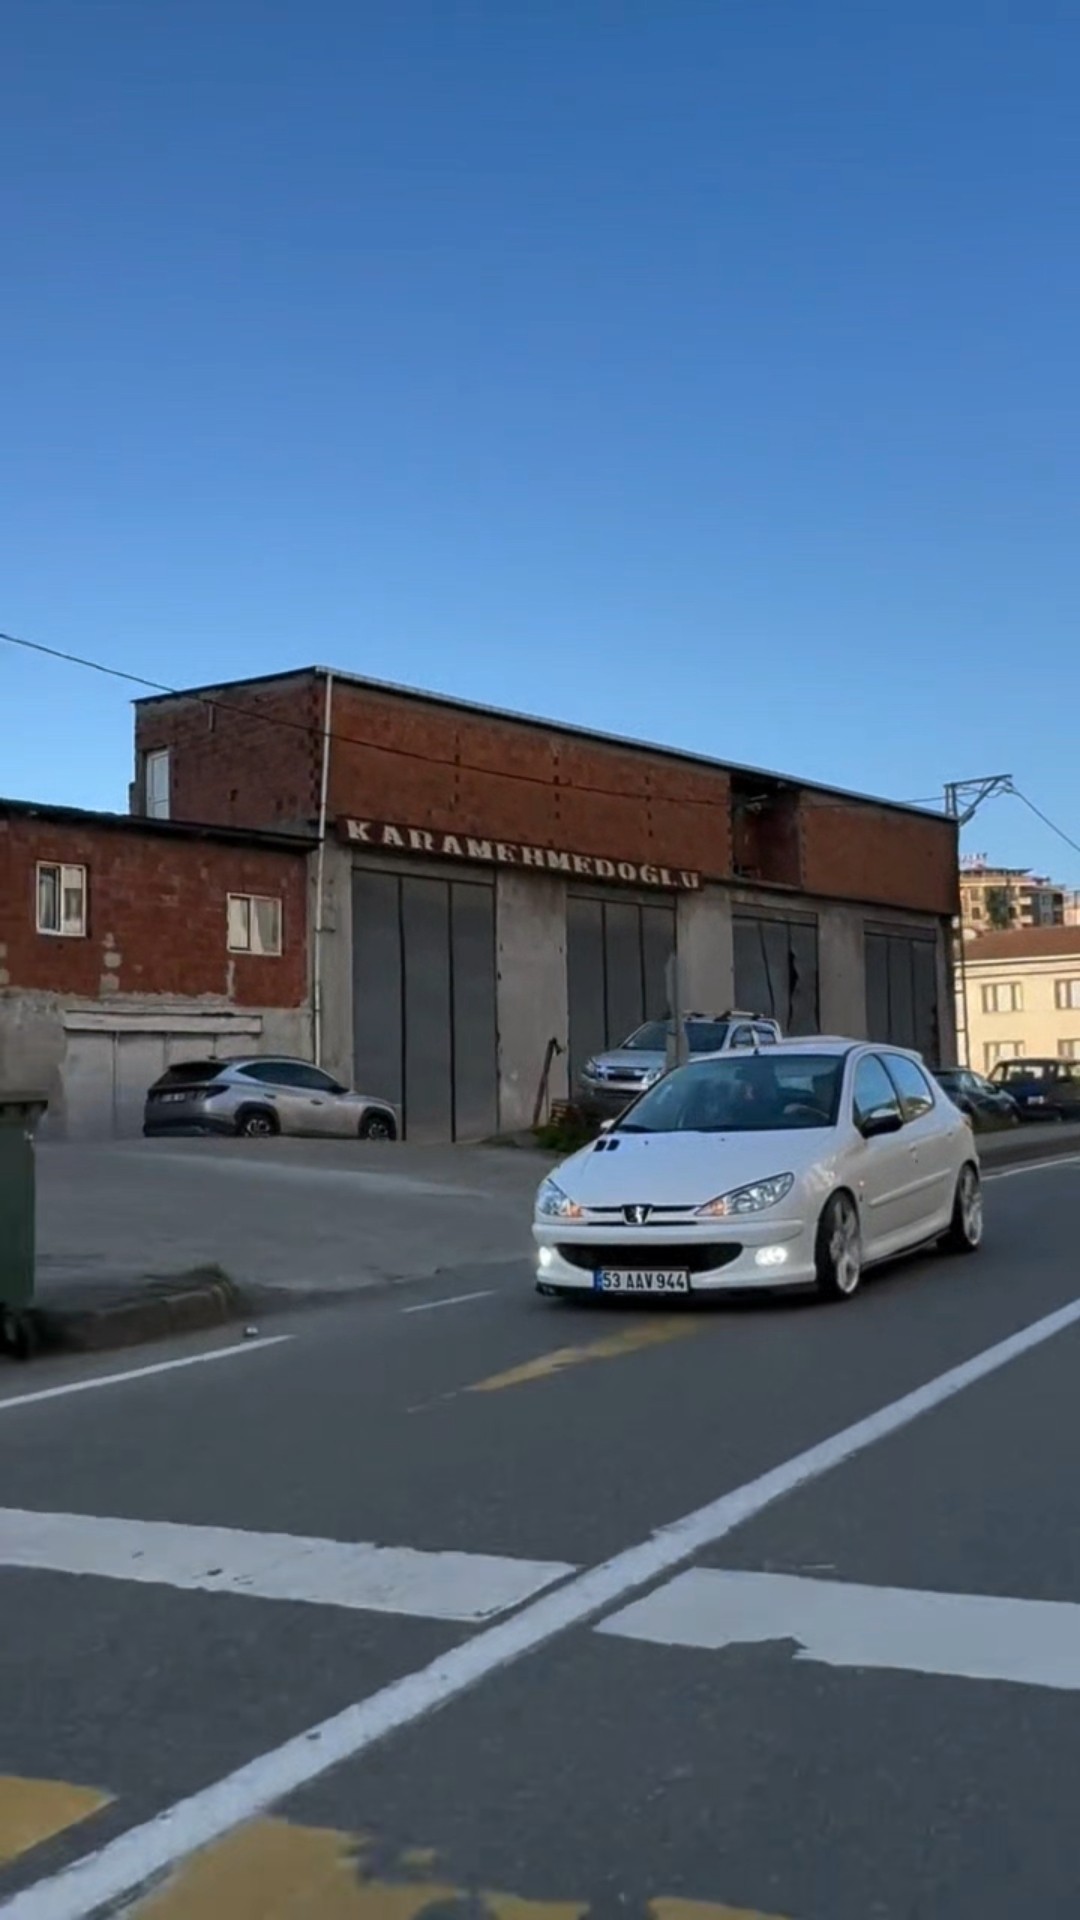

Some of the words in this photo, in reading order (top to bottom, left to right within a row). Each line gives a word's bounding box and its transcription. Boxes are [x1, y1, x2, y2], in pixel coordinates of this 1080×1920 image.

[602, 1272, 621, 1288] 53
[626, 1273, 653, 1289] AAV
[656, 1273, 685, 1289] 944
